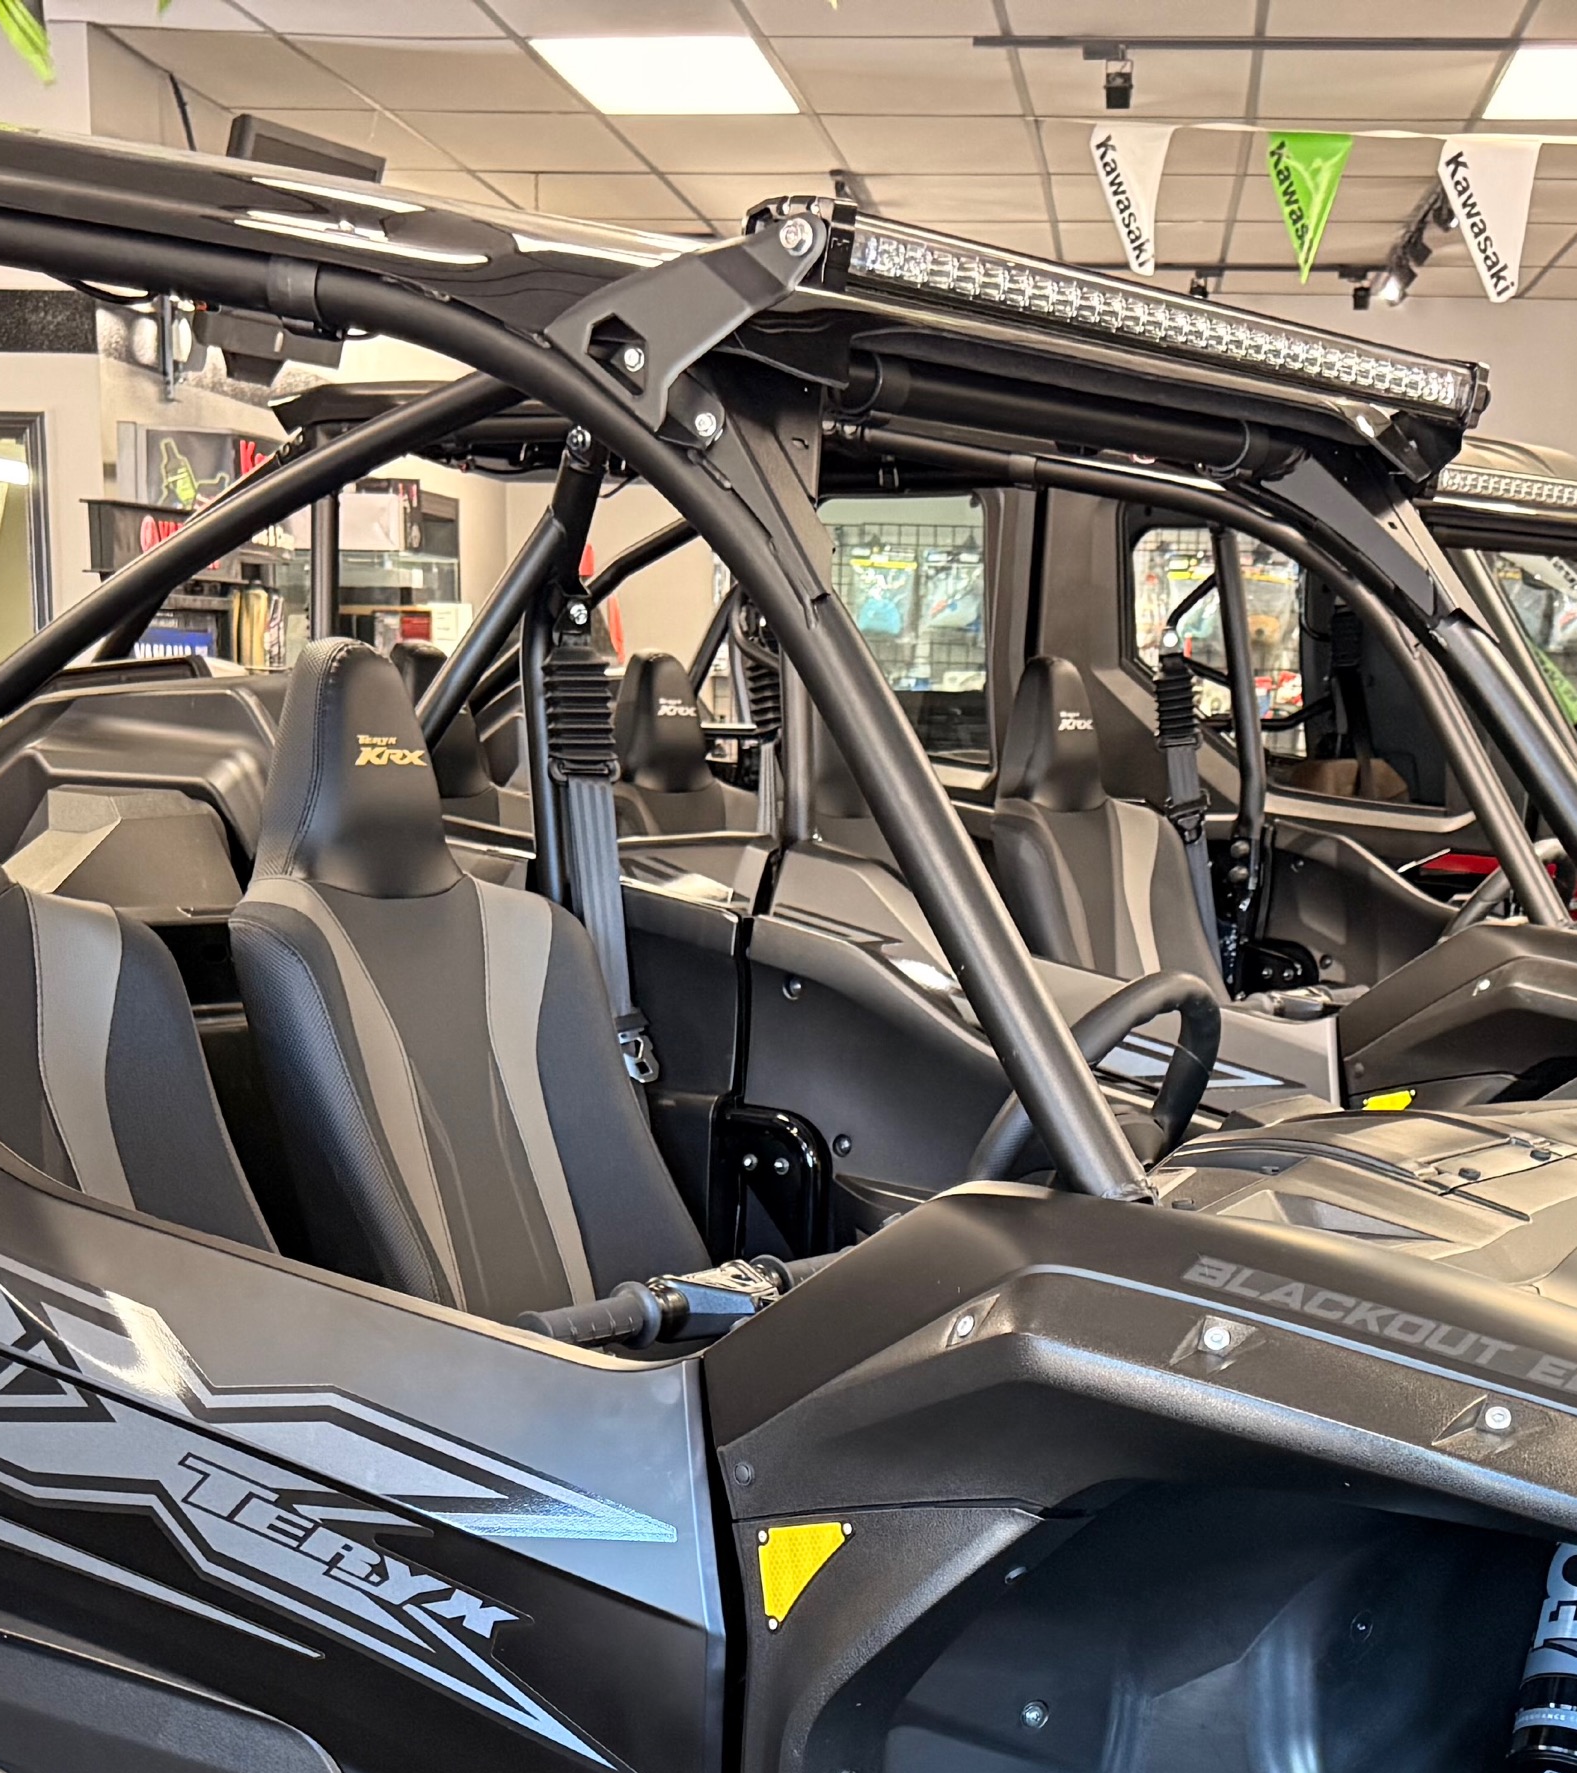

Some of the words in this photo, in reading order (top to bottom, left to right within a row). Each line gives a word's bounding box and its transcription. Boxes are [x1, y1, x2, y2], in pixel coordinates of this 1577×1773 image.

[1095, 134, 1155, 268] Kawasaki
[1270, 141, 1311, 246] Kawas
[1445, 152, 1515, 297] Kawasaki
[355, 747, 427, 766] KRX
[1181, 1254, 1516, 1368] BLACKOUT
[177, 1450, 522, 1641] TERYX
